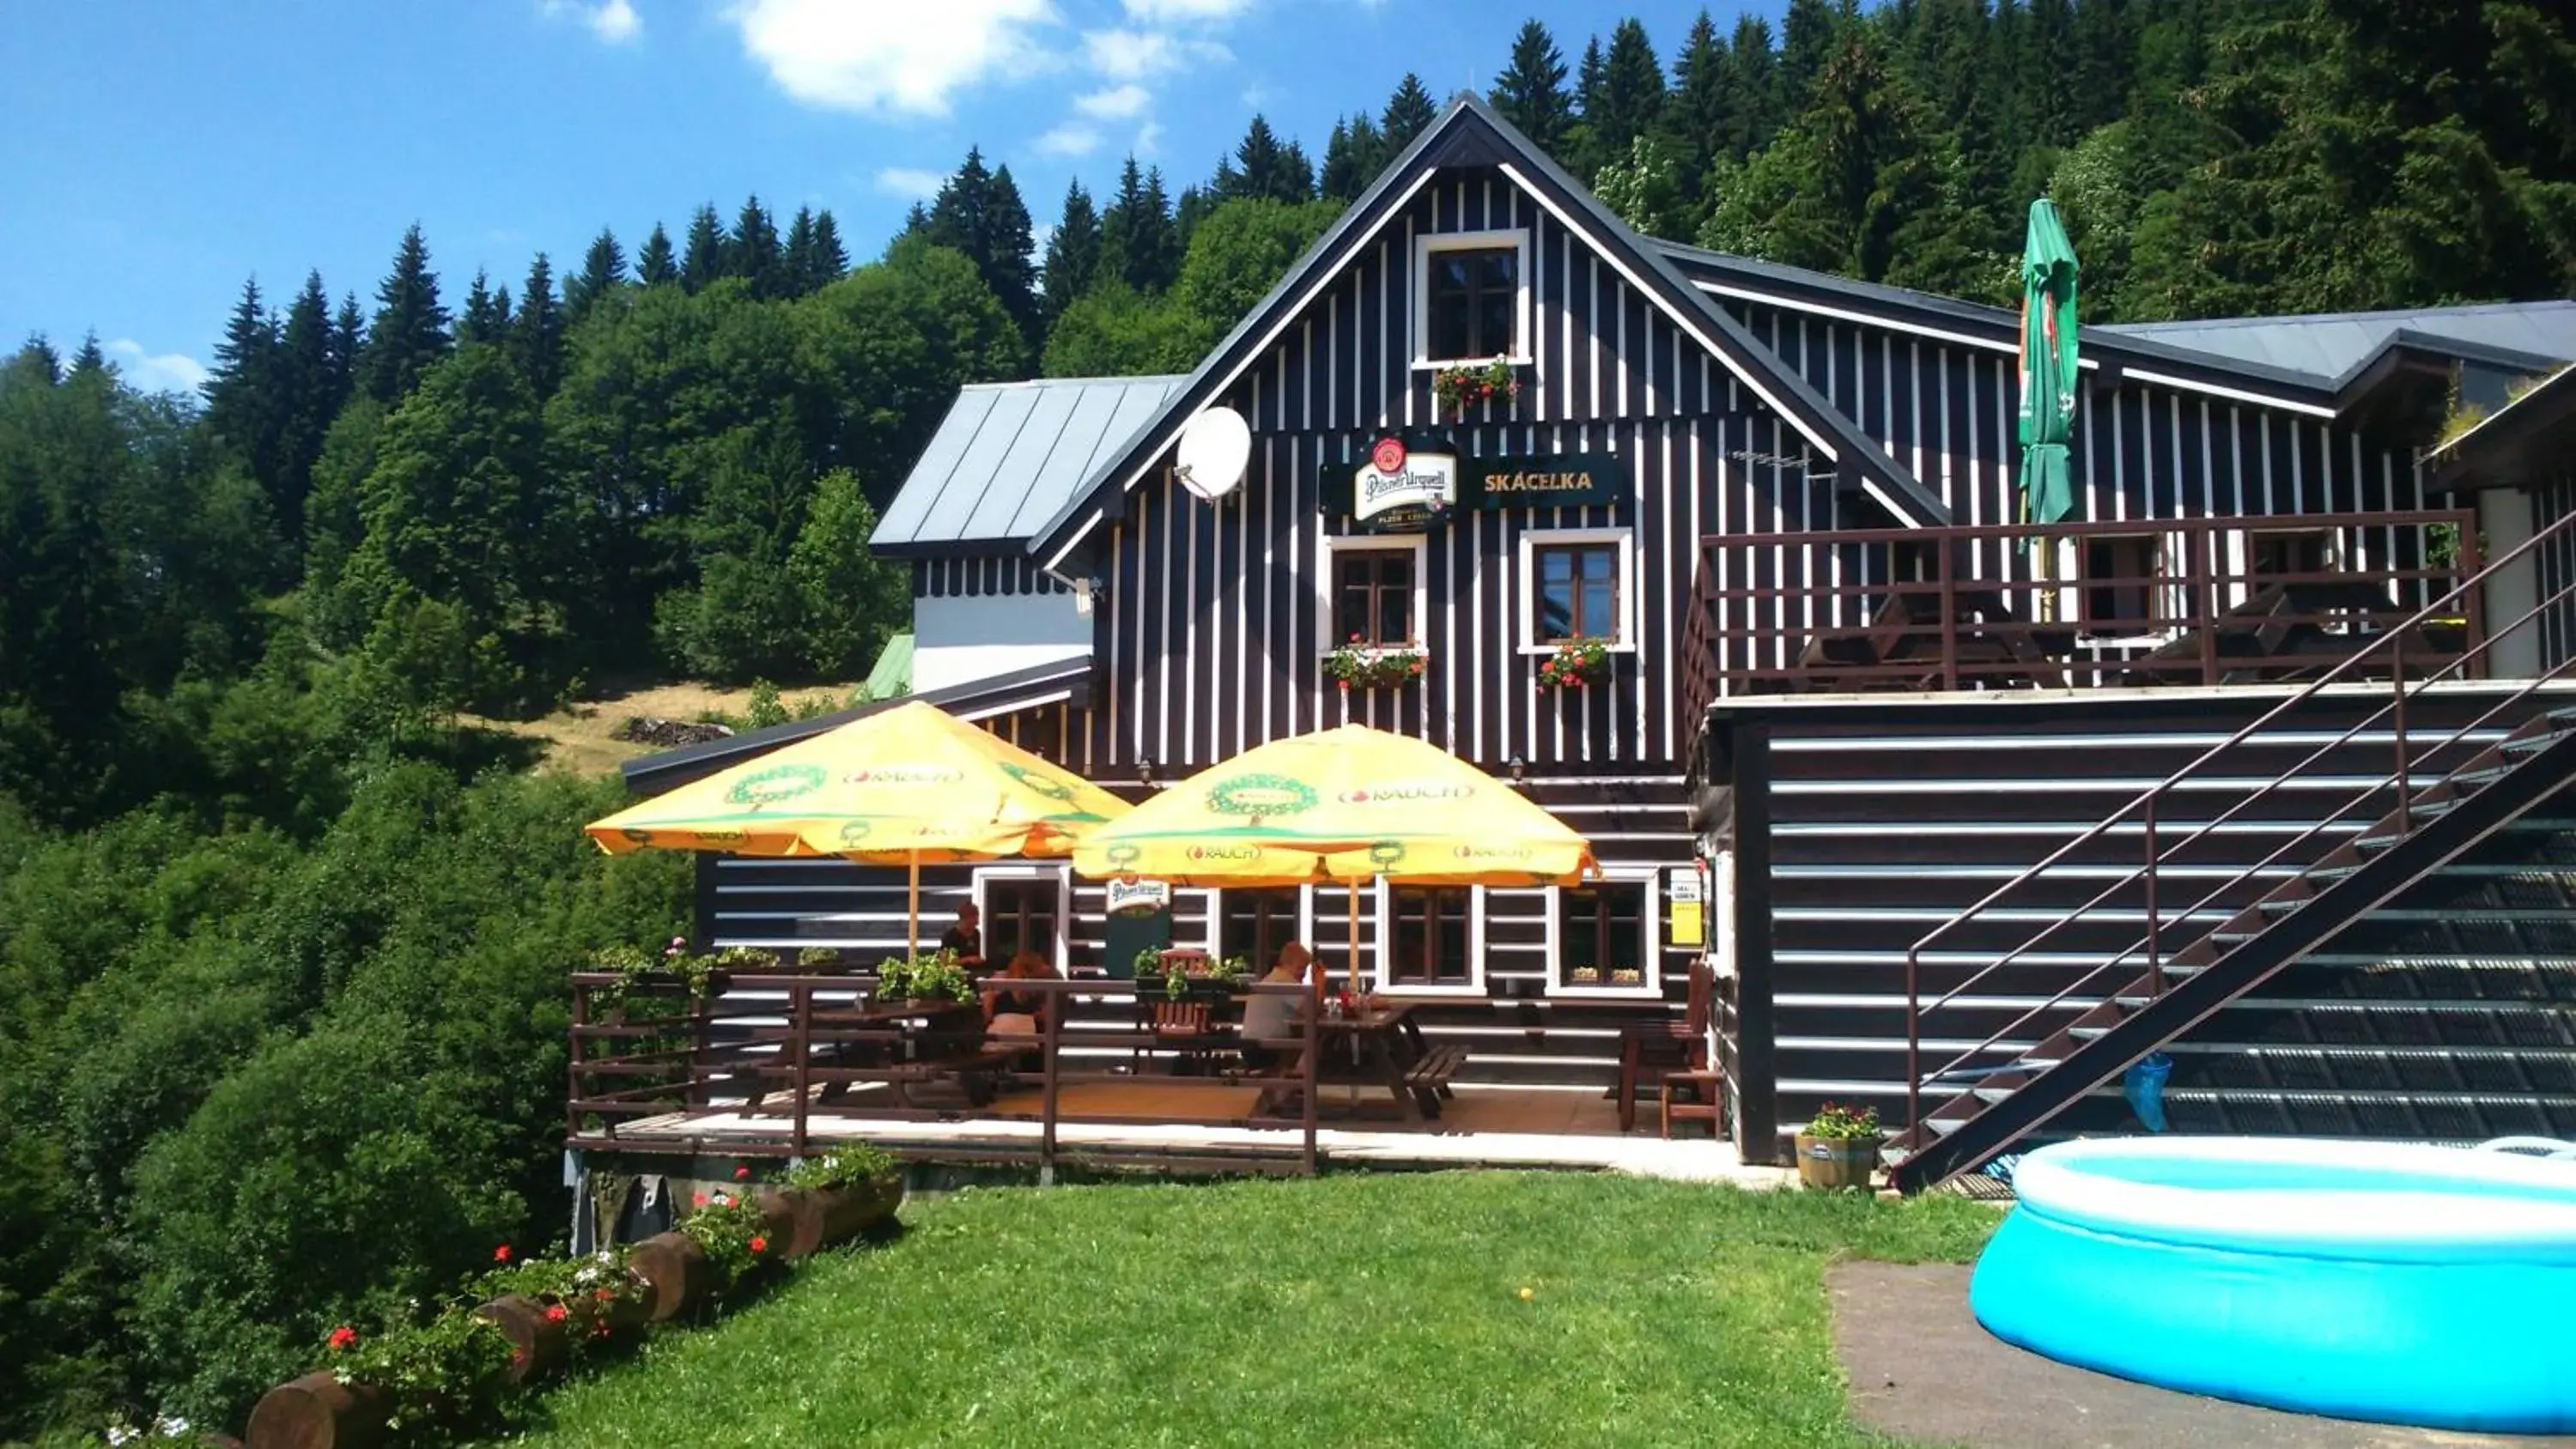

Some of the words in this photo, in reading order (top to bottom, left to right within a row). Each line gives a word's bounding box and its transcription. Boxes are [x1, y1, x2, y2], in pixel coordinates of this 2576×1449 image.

[1365, 473, 1406, 502] Pilsner
[1404, 469, 1445, 490] Urquell
[1484, 470, 1594, 492] SKÁCELKA
[1205, 846, 1253, 859] RAUCH
